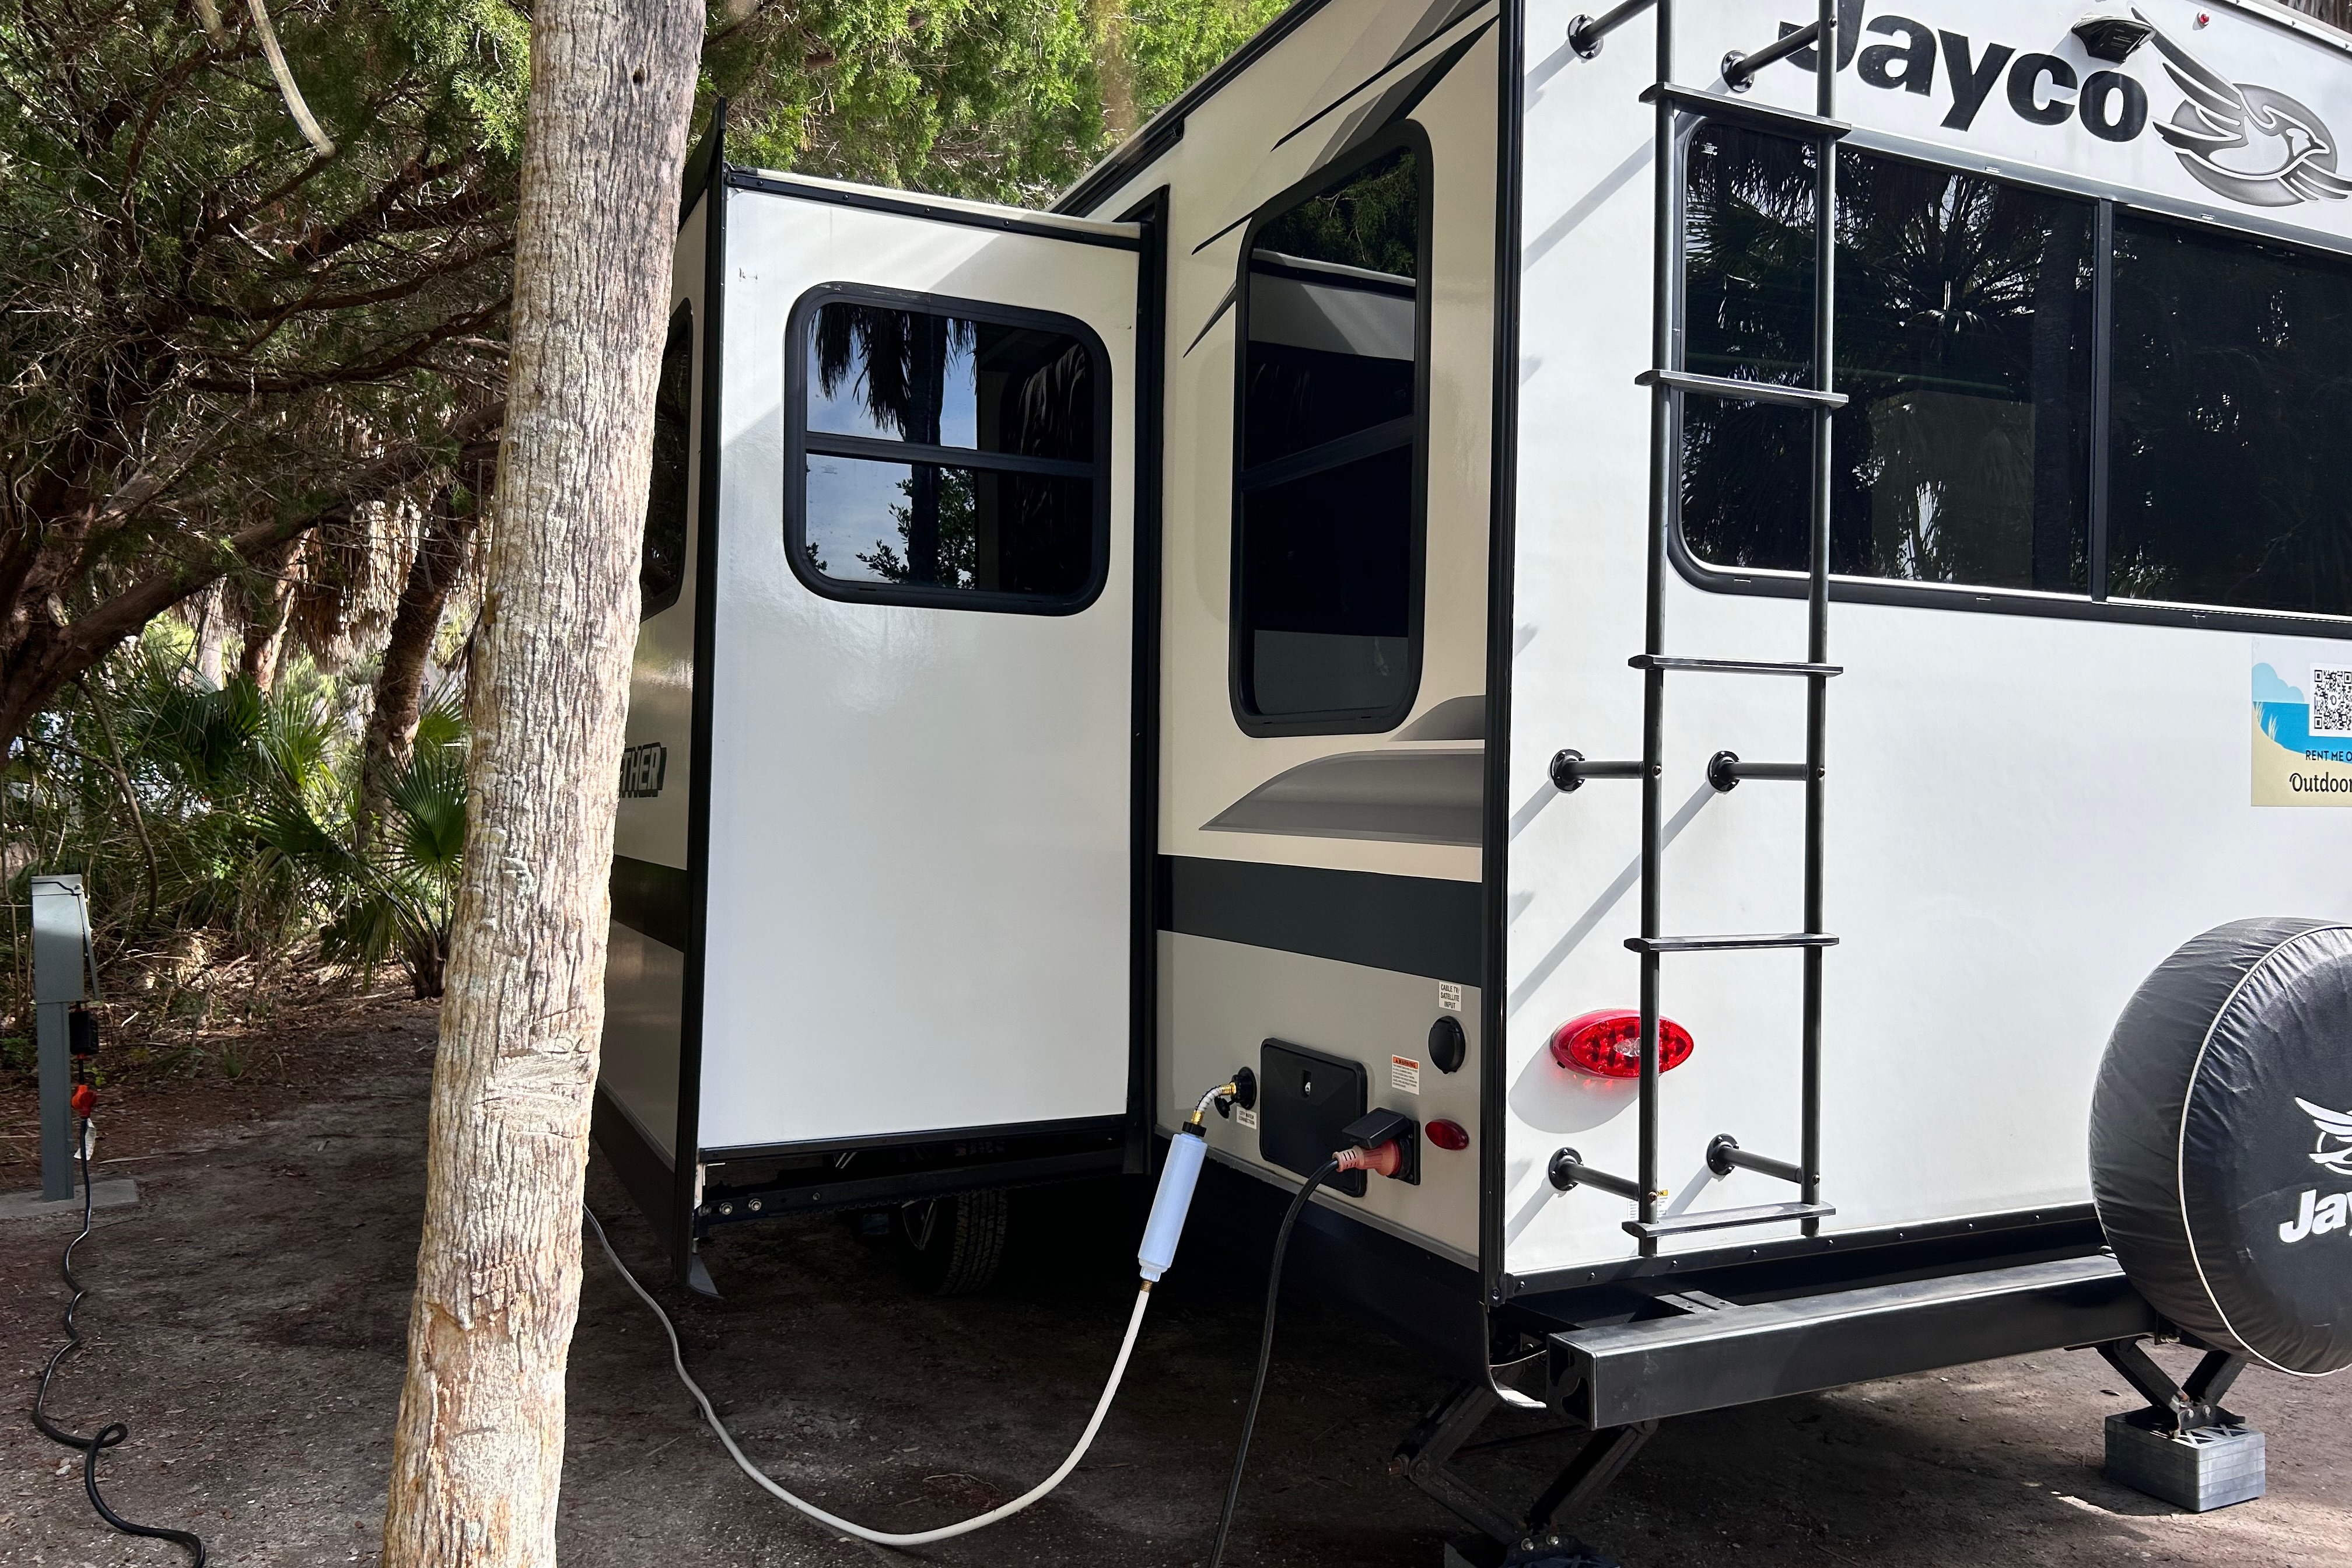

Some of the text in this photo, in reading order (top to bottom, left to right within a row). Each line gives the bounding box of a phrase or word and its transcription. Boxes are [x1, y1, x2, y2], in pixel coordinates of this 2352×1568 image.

[1779, 0, 2148, 142] Jayco
[2306, 750, 2329, 761] RENT
[2332, 751, 2344, 761] ME
[1441, 984, 1452, 992] CABLE
[1441, 992, 1460, 1002] SATELLITE
